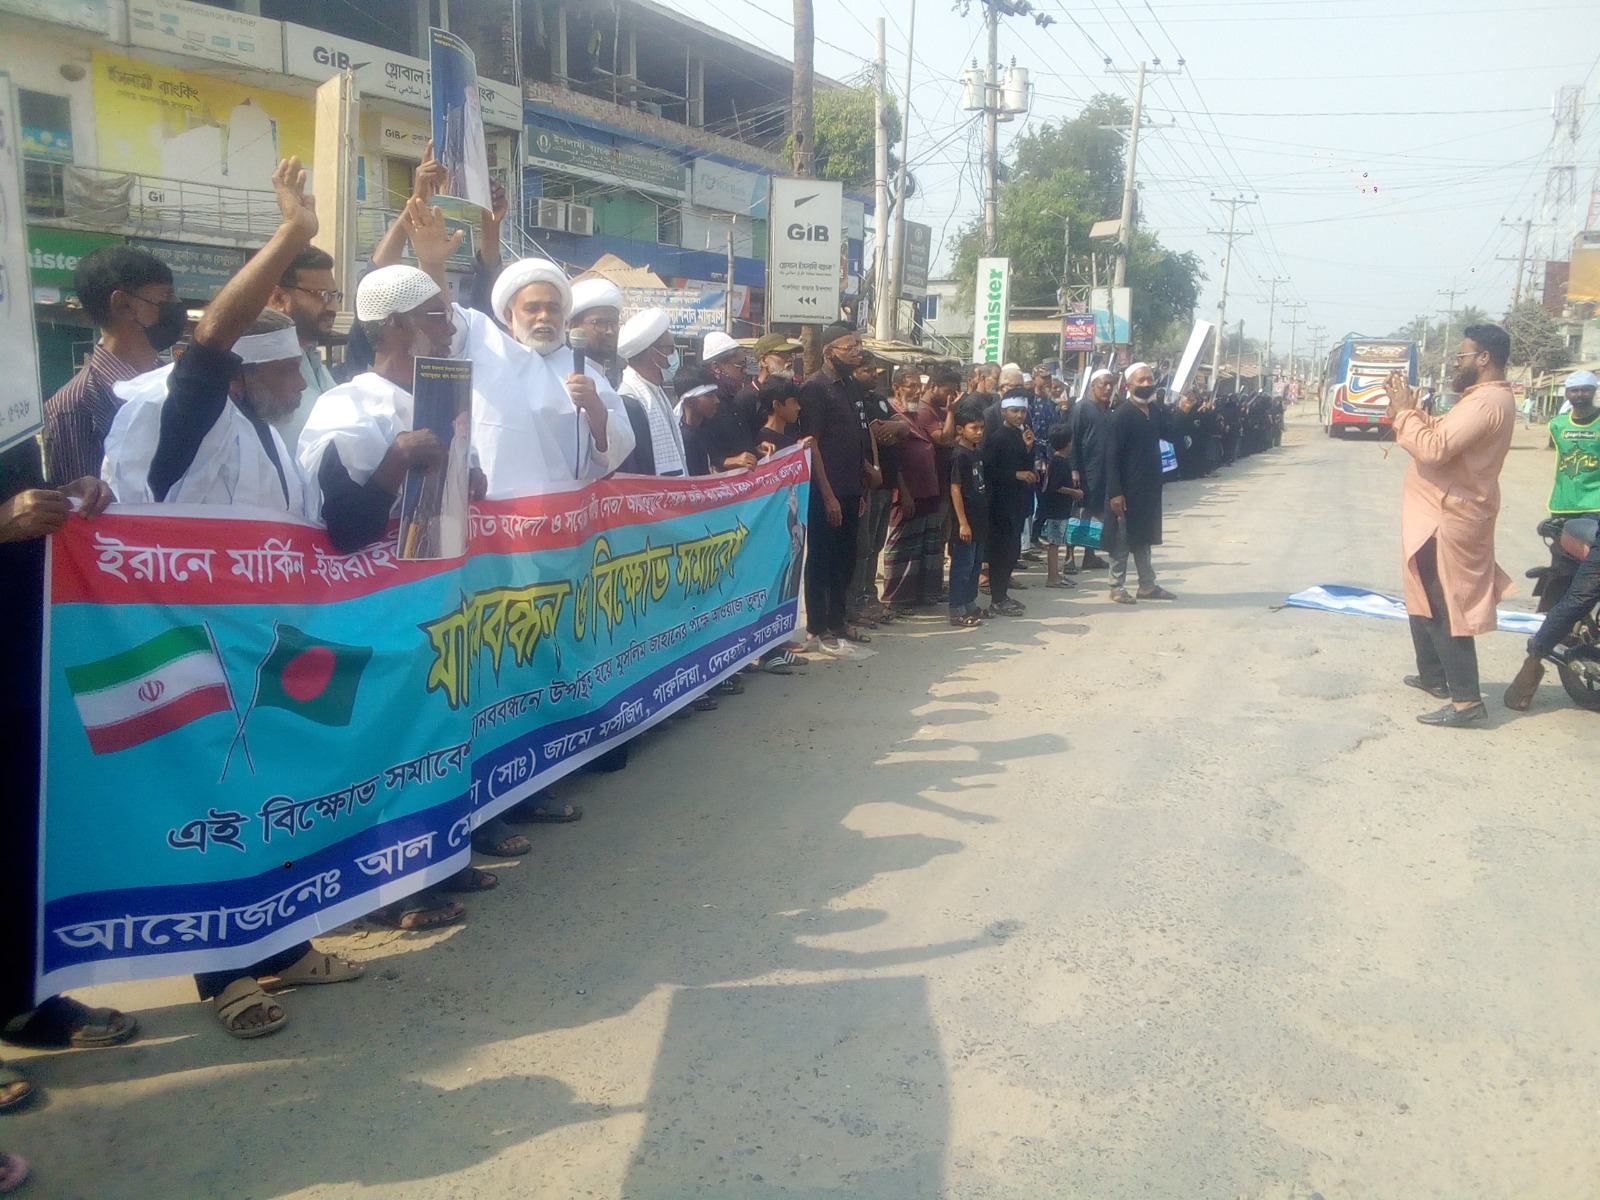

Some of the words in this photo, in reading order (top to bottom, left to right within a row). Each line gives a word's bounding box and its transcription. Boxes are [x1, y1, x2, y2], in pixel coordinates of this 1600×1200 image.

[385, 62, 424, 83] গ্লোবাল
[93, 532, 215, 584] ইরানে
[230, 537, 305, 585] মার্কিন
[499, 512, 547, 540] হামলা
[551, 515, 561, 534] ও
[592, 535, 675, 645] বিক্ষোভ
[167, 810, 248, 853] এই
[259, 775, 380, 843] বিক্ষোভ
[471, 688, 544, 741] ানববন্ধনে
[549, 672, 594, 705] উপস্থিত
[594, 660, 613, 688] হয়ে
[616, 639, 648, 682] মুসলিম
[649, 624, 688, 658] জাহানের
[689, 612, 710, 639] পক্ষে
[710, 599, 745, 626] আওয়াজ
[745, 588, 768, 619] তুলুন
[53, 868, 341, 951] আয়োজনেঃ
[354, 832, 438, 876] আল
[488, 748, 537, 800] (সাঃ)
[543, 730, 591, 760] জামে
[753, 612, 793, 645] সাতক্ষীরা
